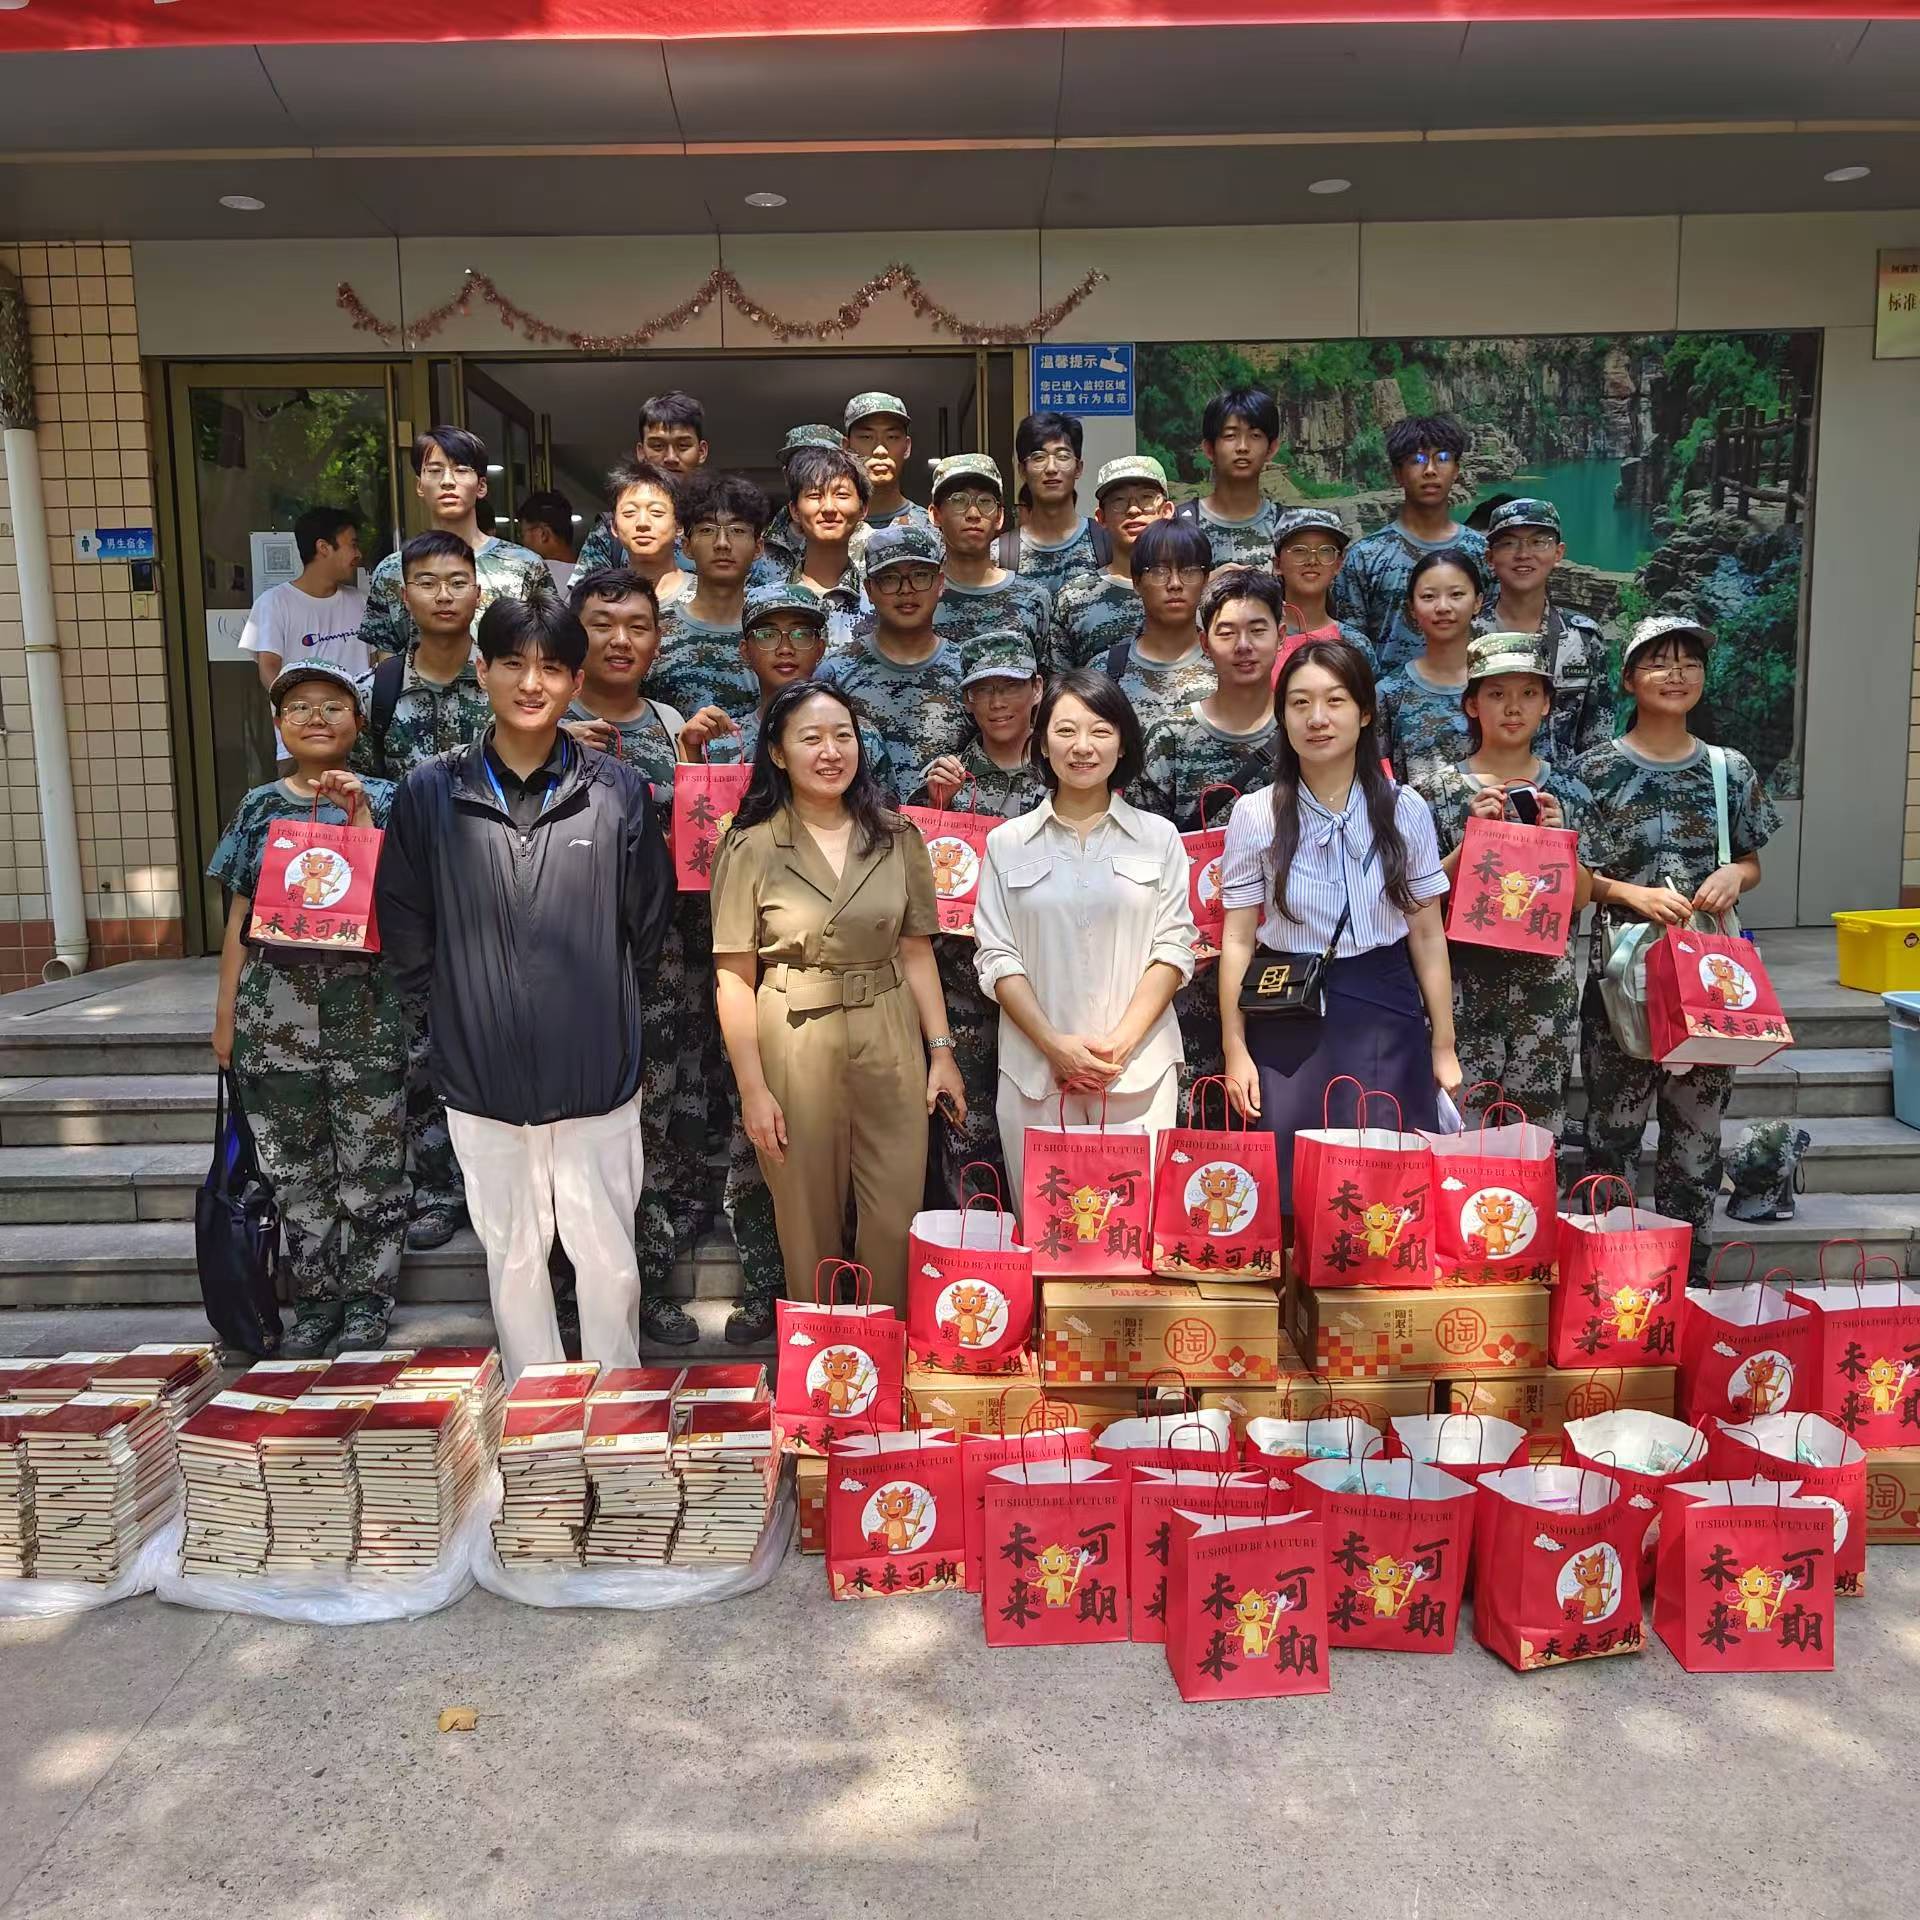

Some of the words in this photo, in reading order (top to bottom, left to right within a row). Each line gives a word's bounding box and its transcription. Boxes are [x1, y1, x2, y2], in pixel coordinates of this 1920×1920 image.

[1040, 354, 1098, 369] 温馨提示
[1040, 380, 1126, 391] 您已进入监控区域
[1040, 393, 1127, 405] 请注意行为规范
[106, 537, 146, 550] 男生宿舍
[302, 628, 361, 646] Champio
[266, 913, 360, 940] 未来可期
[1033, 1143, 1042, 1152] IT
[1043, 1143, 1082, 1154] SHOULD
[1084, 1144, 1097, 1154] BE
[1034, 1165, 1073, 1261] 未来
[1104, 1169, 1142, 1260] 可期
[1322, 1180, 1364, 1273] 未来
[1392, 1183, 1430, 1272] 可期
[1169, 1241, 1273, 1271] 未来可期
[802, 1323, 841, 1336] SHOULD
[1833, 1341, 1870, 1433] 未来
[507, 1436, 533, 1446] A5
[593, 1436, 617, 1446] A5
[698, 1433, 722, 1443] A5
[994, 1498, 1005, 1507] IT
[1006, 1497, 1051, 1507] SHOULD
[1075, 1496, 1118, 1505] FUTURE
[1141, 1496, 1151, 1504] IT
[1343, 1506, 1388, 1519] SHOULD
[1695, 1521, 1705, 1529] IT
[1706, 1519, 1752, 1529] SHOULD
[1196, 1551, 1206, 1560] IT
[1207, 1543, 1248, 1558] SHOULD
[1250, 1541, 1262, 1550] BE
[1272, 1538, 1317, 1549] FUTURE
[850, 1557, 957, 1593] 未来可期
[999, 1522, 1041, 1629] 未来
[1075, 1522, 1118, 1626] 可期
[1328, 1531, 1369, 1633] 未来
[1403, 1538, 1450, 1637] 可期
[1697, 1544, 1741, 1655] 未来
[1777, 1548, 1824, 1652] 可期
[1197, 1572, 1239, 1682] 未来
[1274, 1566, 1319, 1676] 可期
[1540, 1622, 1642, 1661] 未来可期
